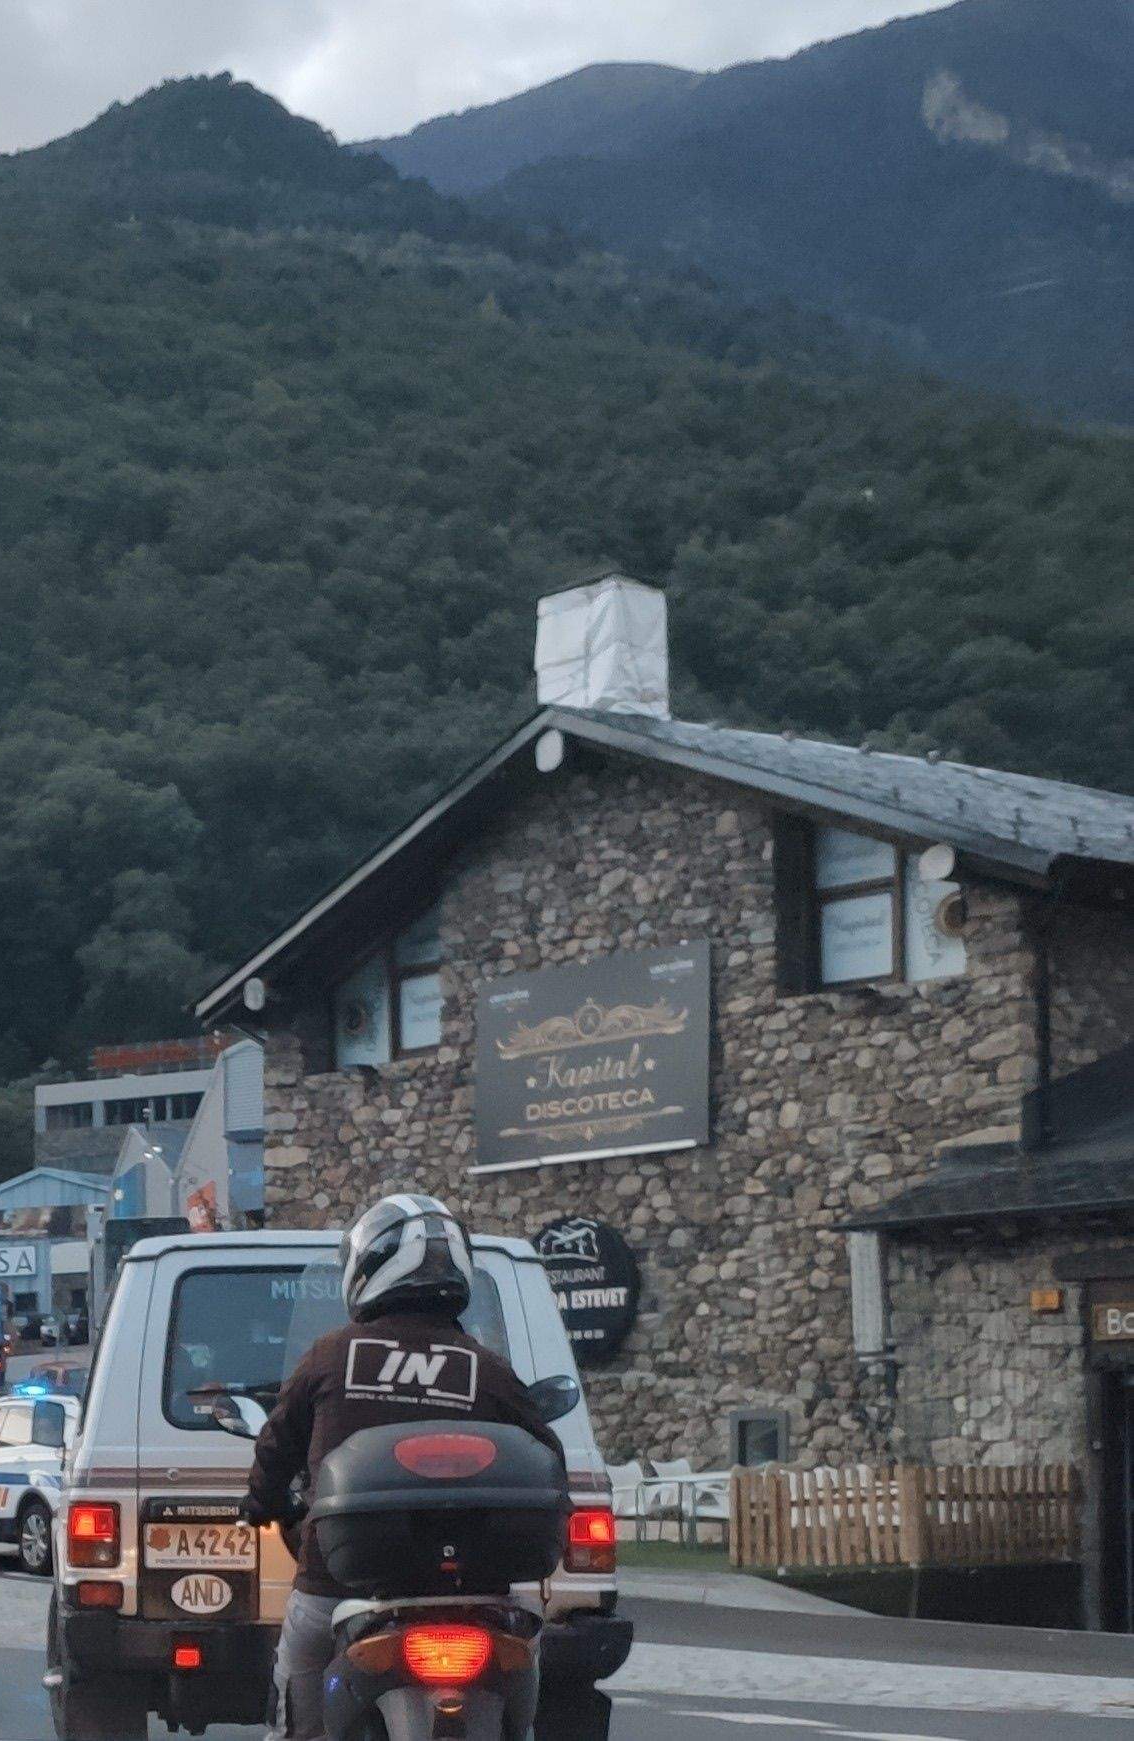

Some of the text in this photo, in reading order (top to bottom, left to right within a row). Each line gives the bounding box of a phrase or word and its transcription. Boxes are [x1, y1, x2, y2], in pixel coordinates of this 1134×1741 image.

[526, 1088, 655, 1121] DISCOTECA
[571, 1287, 627, 1309] ESTEVET
[377, 1350, 448, 1386] IN
[177, 1526, 252, 1556] A4242
[180, 1578, 225, 1607] AND
